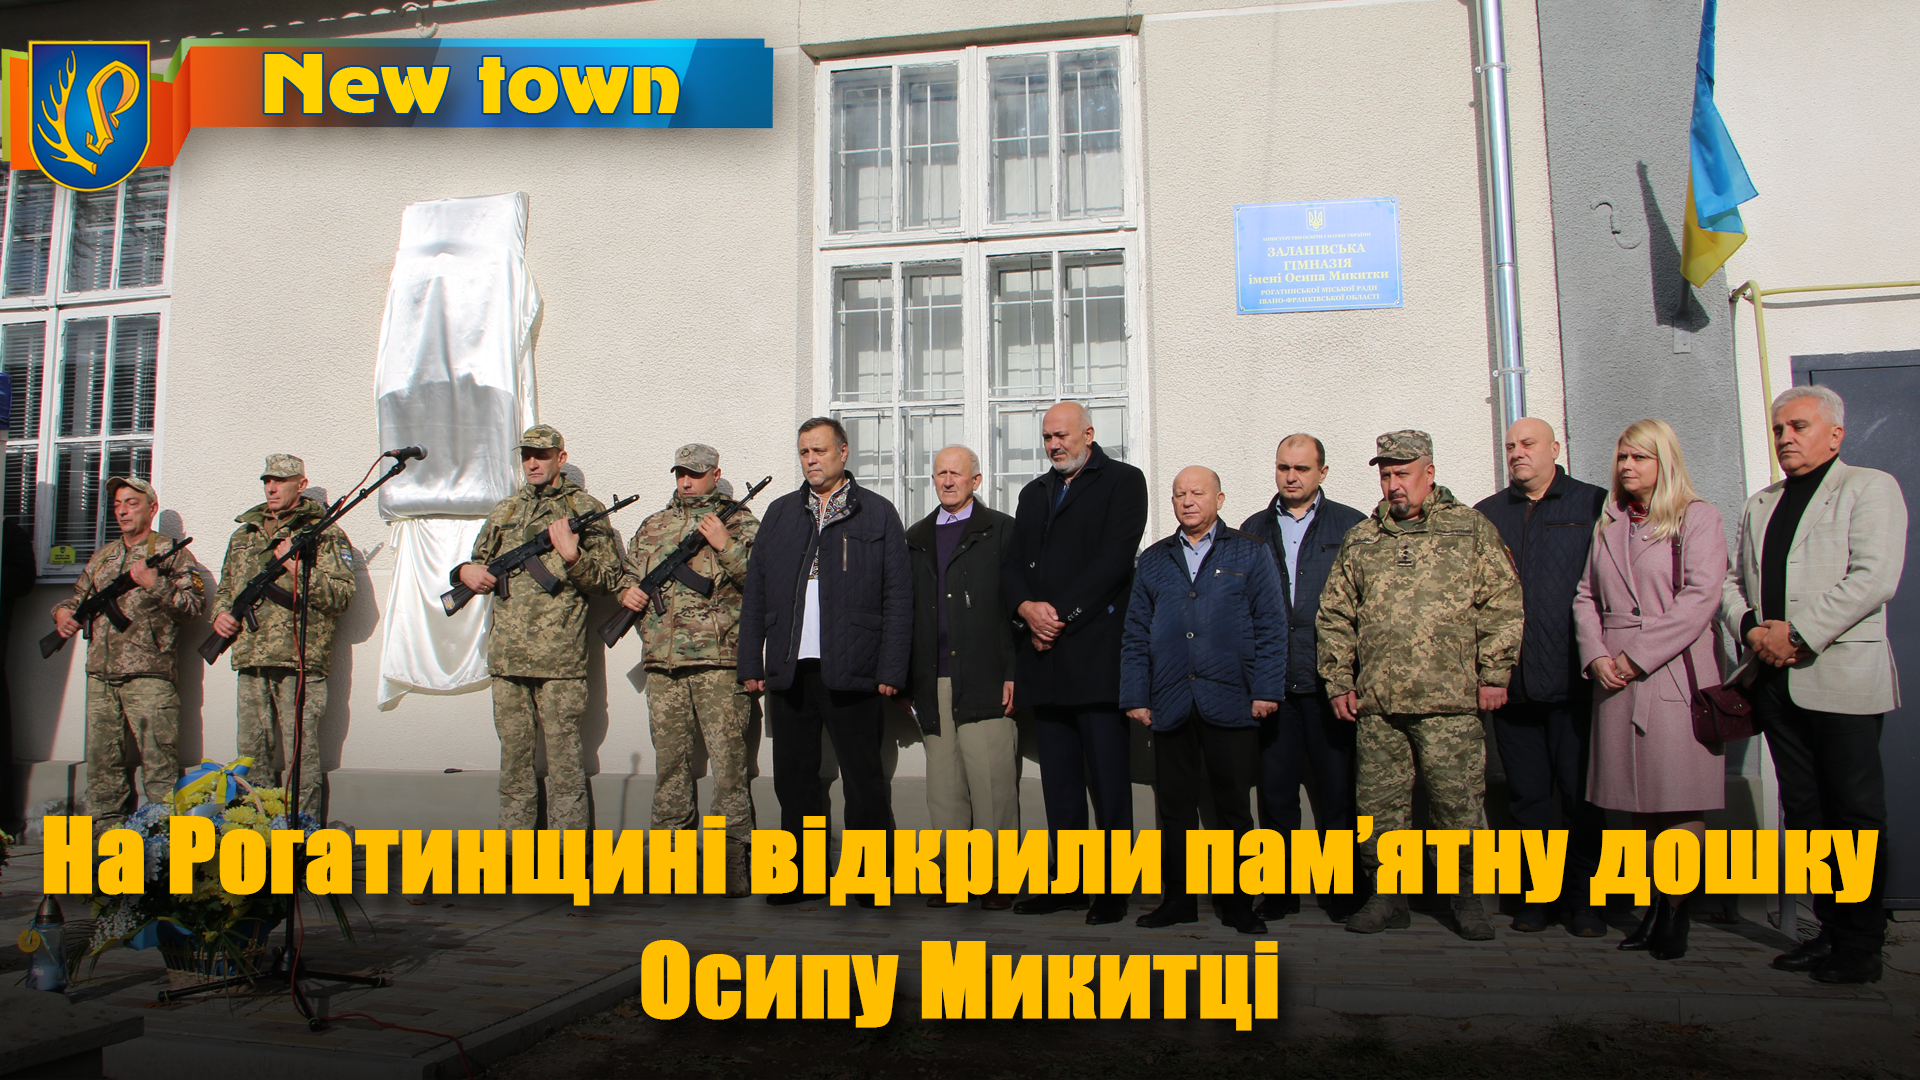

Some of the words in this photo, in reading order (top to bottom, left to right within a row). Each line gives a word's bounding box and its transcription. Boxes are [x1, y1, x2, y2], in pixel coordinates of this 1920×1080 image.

[1267, 243, 1366, 257] ЗАЛАНІВСЬКА
[1284, 258, 1352, 271] ГІМНАЗІЯ
[1248, 273, 1282, 284] імені
[1285, 272, 1325, 283] Осипа
[1329, 270, 1389, 281] Микитки
[1261, 286, 1320, 295] РОГАТИНСЬКОЇ
[1322, 285, 1355, 293] МІСЬКОЇ
[1259, 294, 1345, 304] ІВАНО-ФРАНКІВСЬКОЇ
[1346, 293, 1380, 301] ОБЛАСТІ
